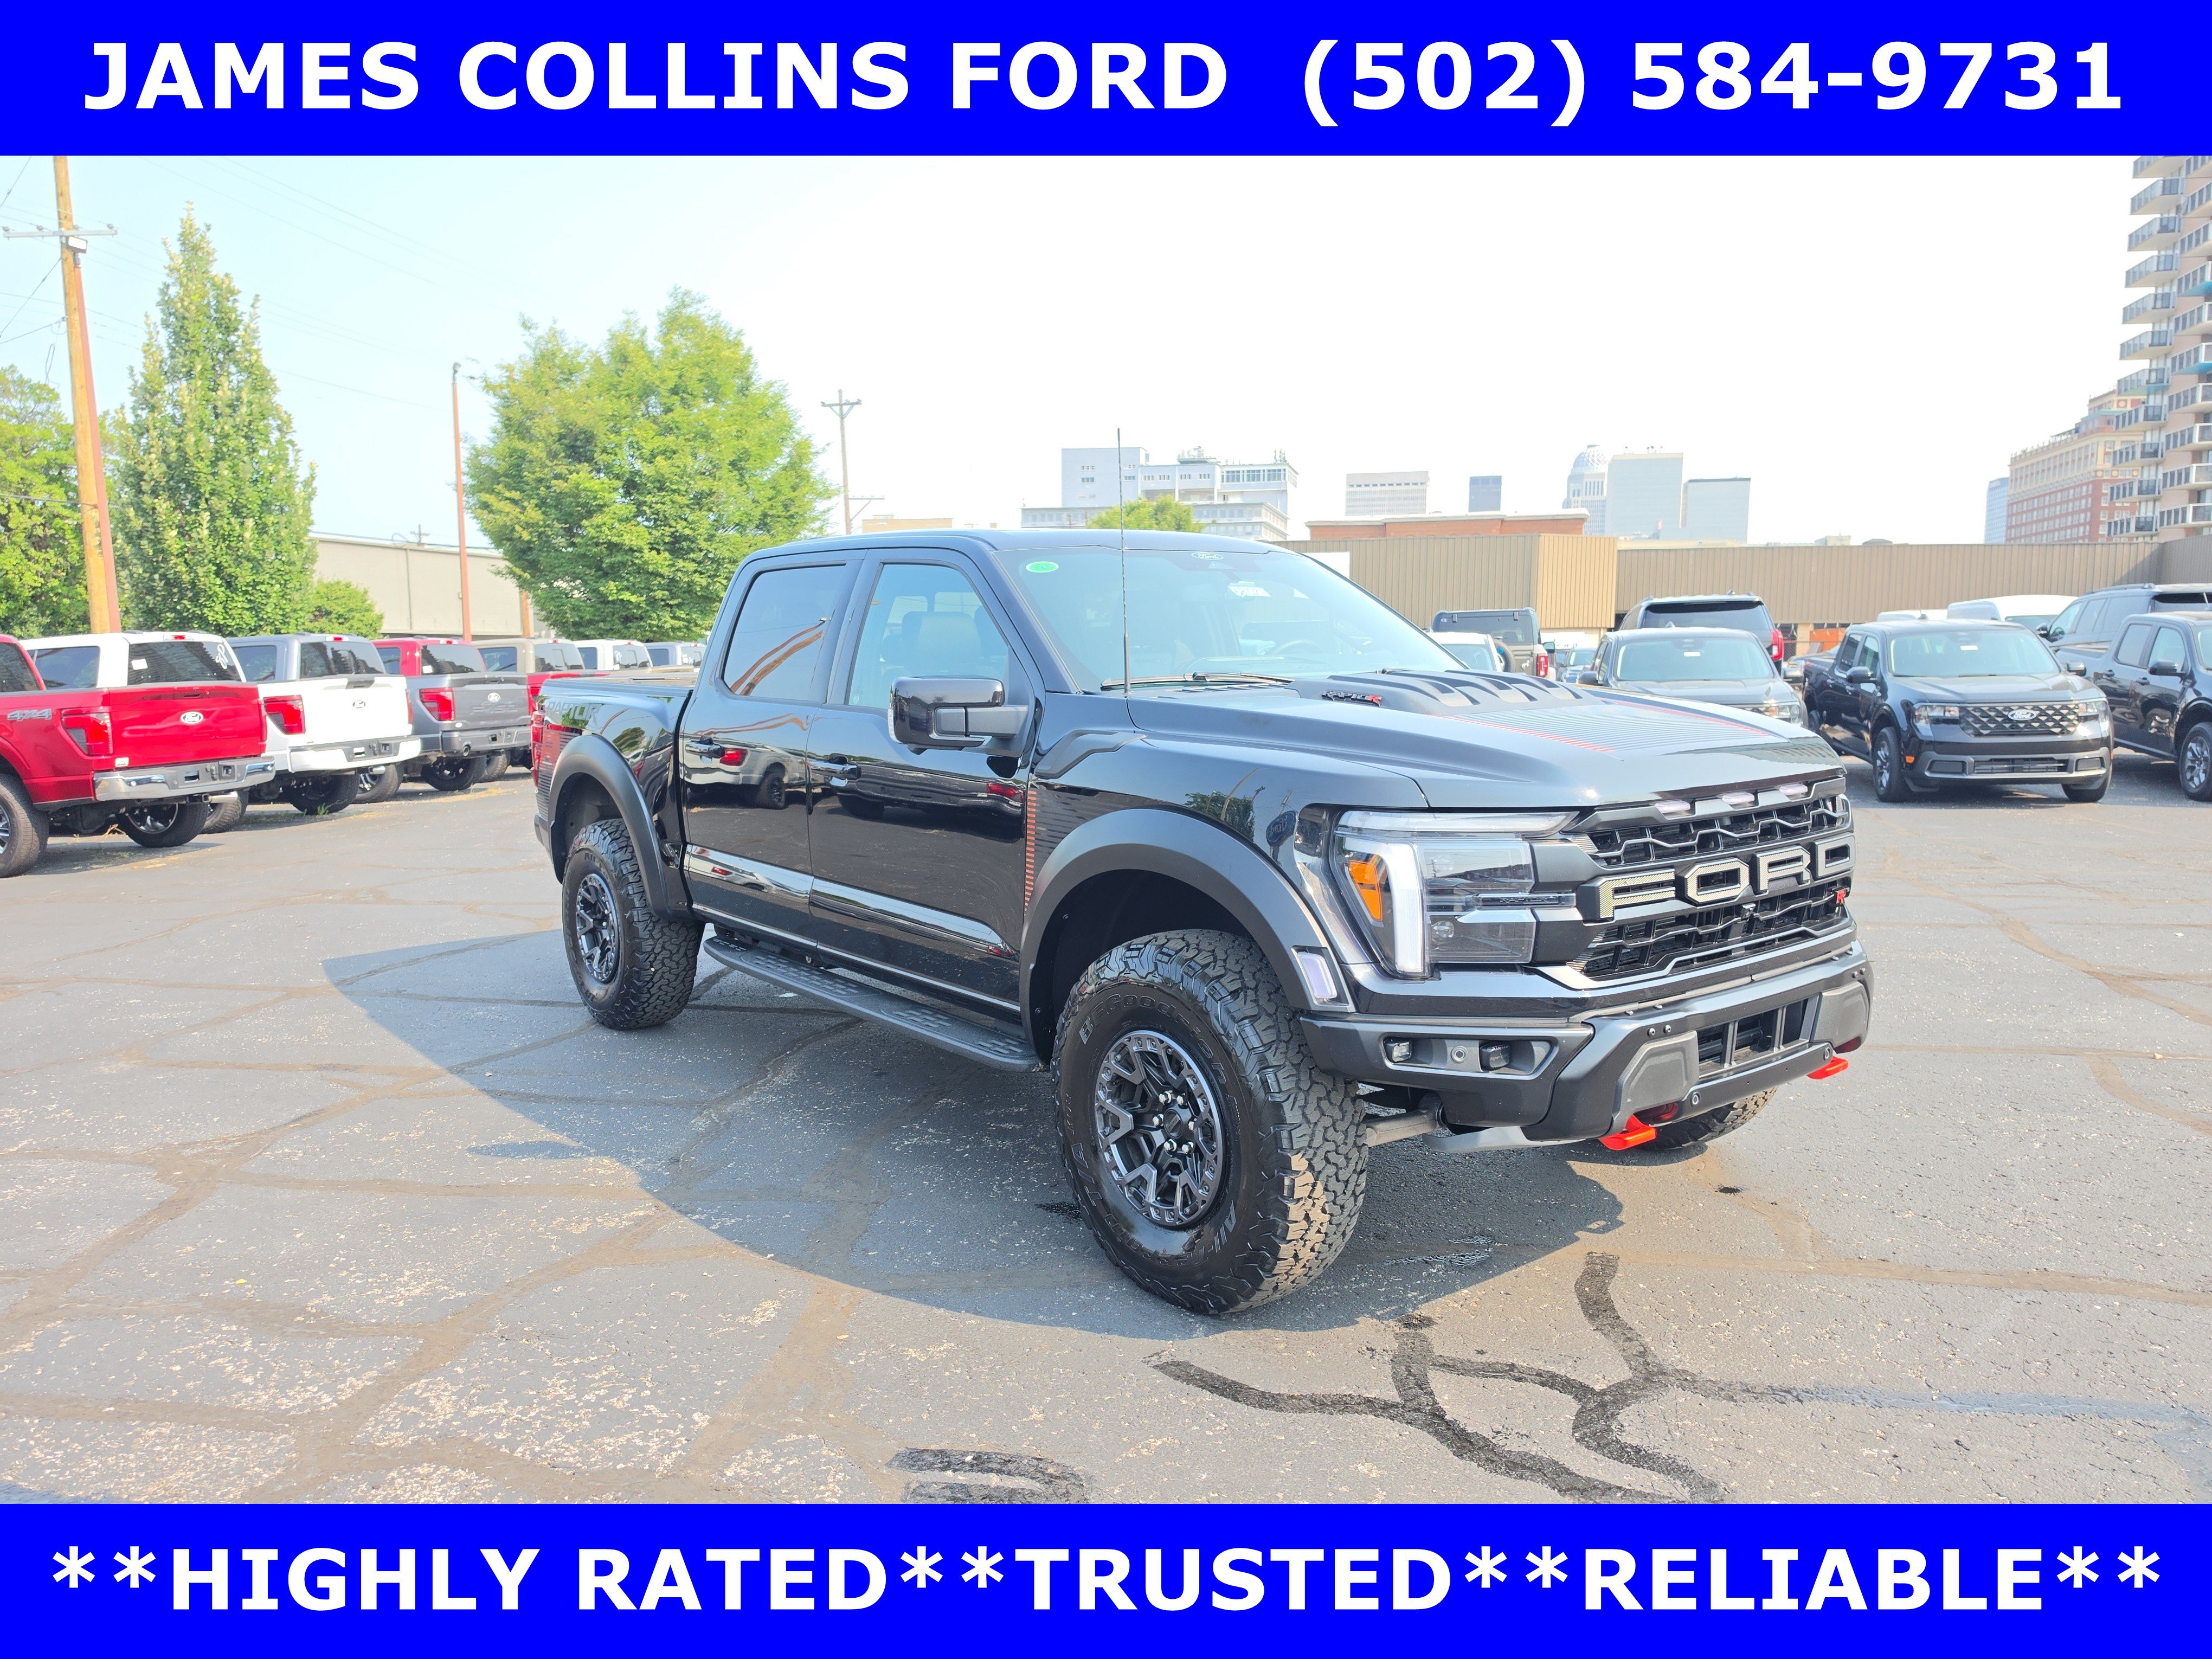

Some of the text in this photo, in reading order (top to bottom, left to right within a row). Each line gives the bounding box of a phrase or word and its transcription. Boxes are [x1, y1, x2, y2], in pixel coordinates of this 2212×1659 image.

[1322, 689, 1382, 707] RAPTOR
[1599, 834, 1855, 919] FORD
[1078, 993, 1227, 1085] BFGoodrich
